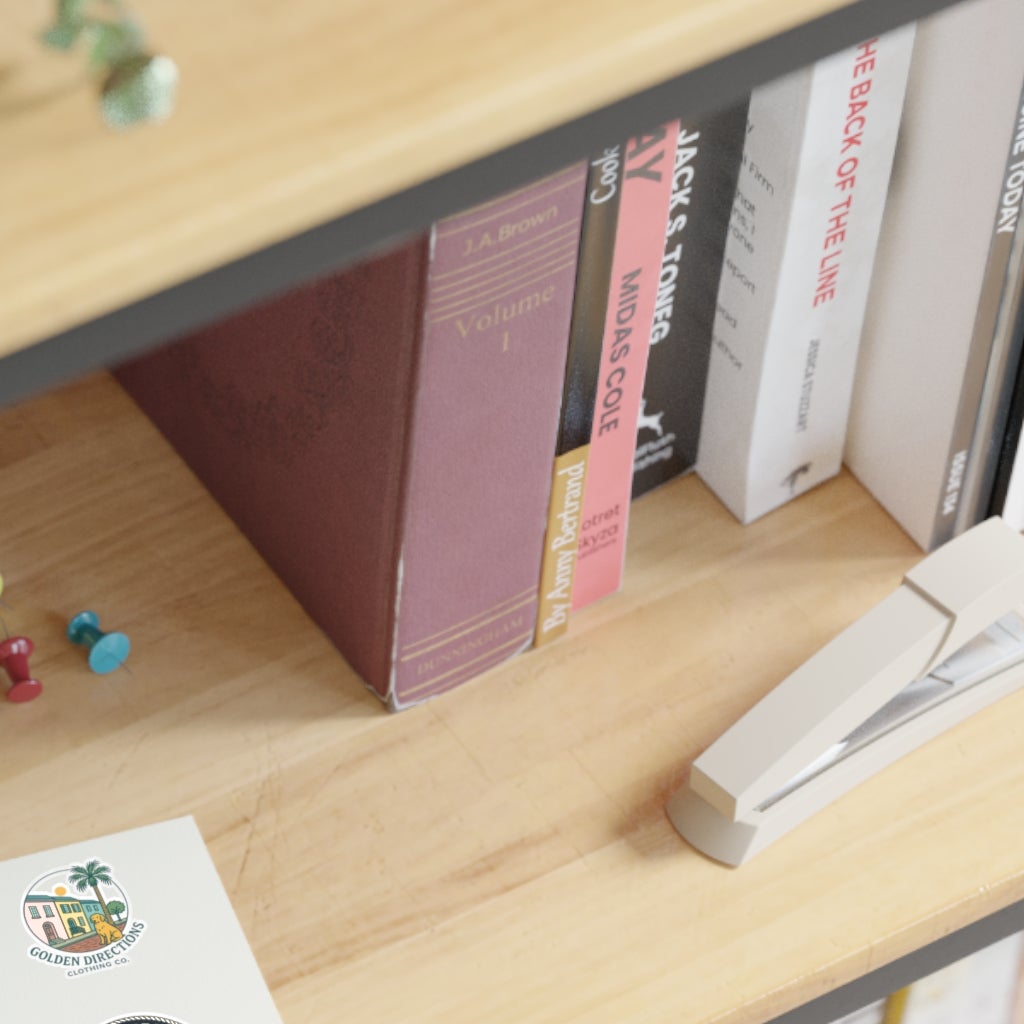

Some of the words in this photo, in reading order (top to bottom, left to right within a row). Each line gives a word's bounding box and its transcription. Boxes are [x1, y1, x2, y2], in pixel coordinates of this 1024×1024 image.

[852, 36, 880, 79] HE
[842, 78, 873, 154] BACK
[625, 125, 667, 184] AY
[666, 128, 701, 213] JACK
[835, 156, 859, 191] OF
[824, 194, 853, 250] THE
[727, 258, 756, 295] eport
[812, 249, 842, 309] LINE
[454, 285, 557, 338] Volume
[609, 267, 643, 365] MIDAS
[598, 366, 627, 438] COLE
[551, 460, 585, 551] Bertrand
[581, 504, 621, 532] otret
[542, 602, 571, 633] By
[30, 946, 80, 967] GOLDEN
[83, 921, 145, 966] DIRECTIONS
[67, 961, 112, 977] CLOTHING
[114, 957, 130, 965] CO.
